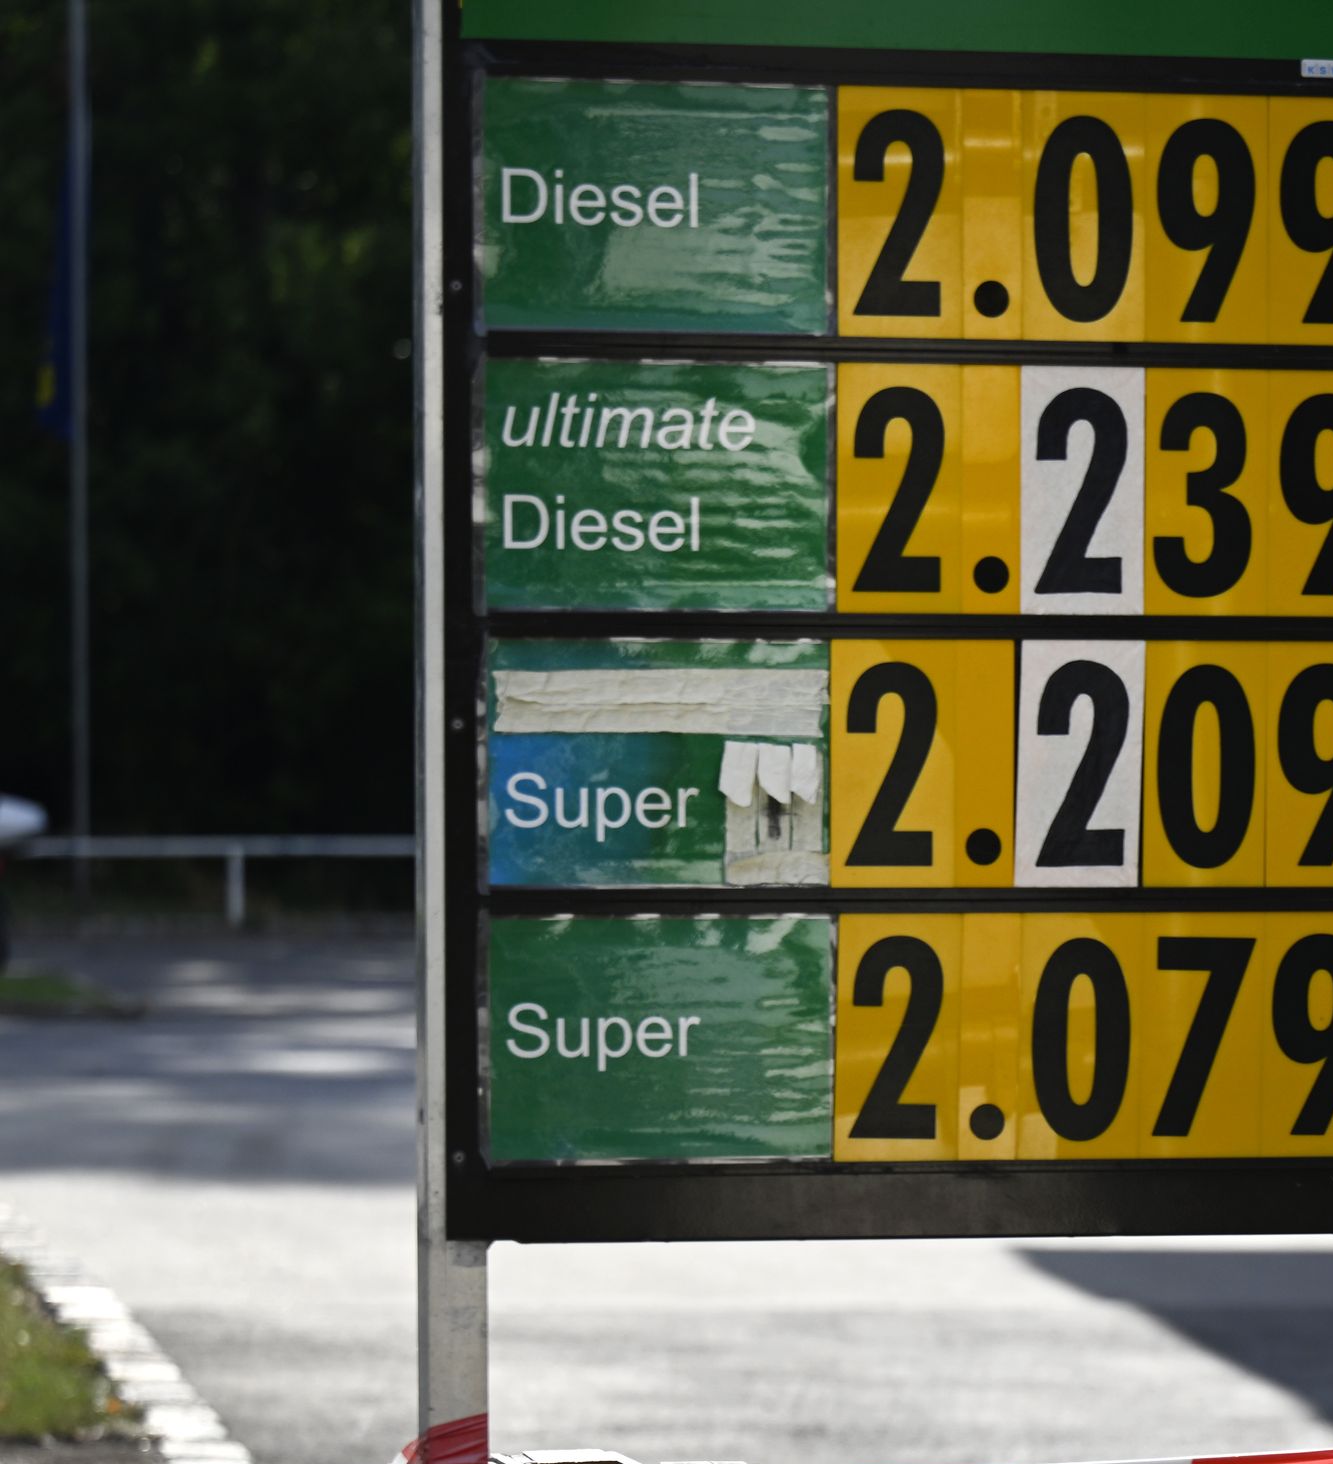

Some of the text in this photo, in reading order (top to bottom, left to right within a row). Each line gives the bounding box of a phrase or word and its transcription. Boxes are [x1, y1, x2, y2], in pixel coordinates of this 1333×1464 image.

[500, 168, 700, 229] Diesel
[500, 393, 756, 450] ultimate
[501, 494, 701, 552] Diesel
[504, 772, 700, 842] Super
[506, 1003, 702, 1072] Super
